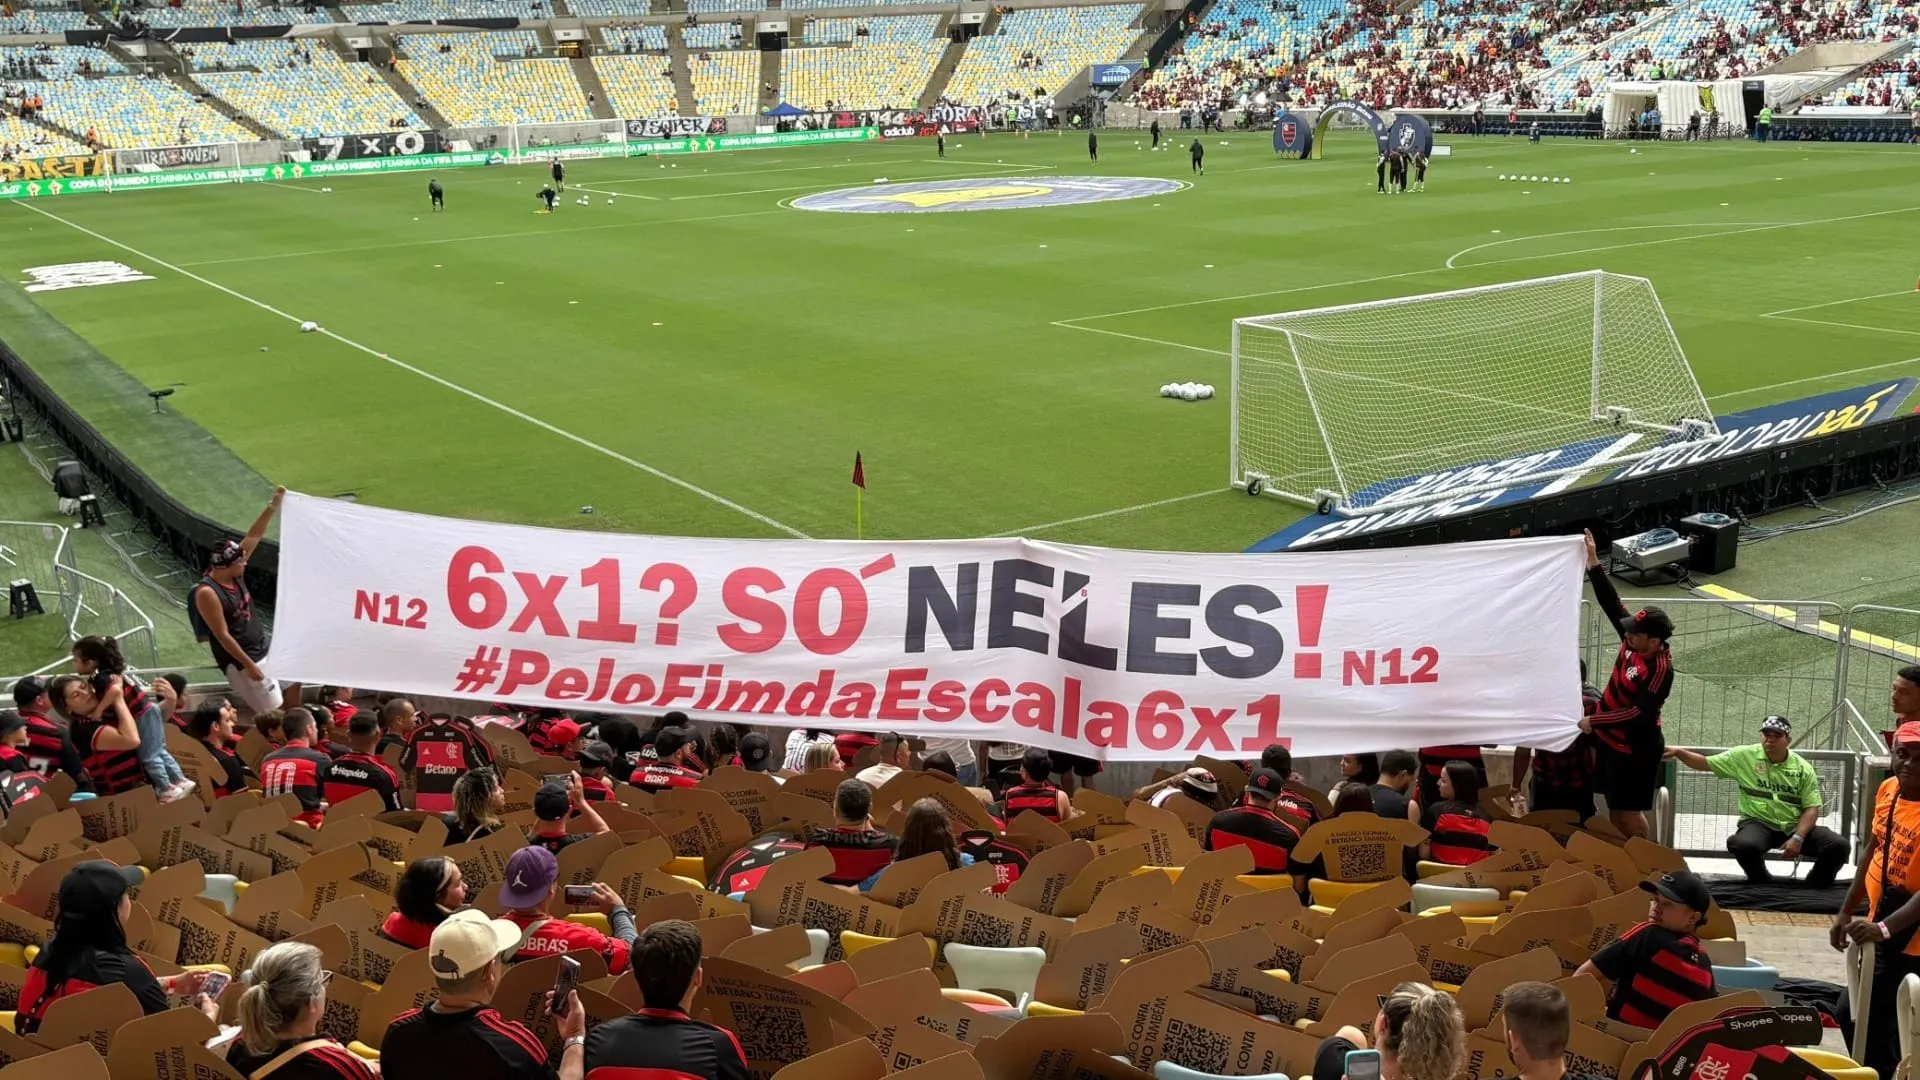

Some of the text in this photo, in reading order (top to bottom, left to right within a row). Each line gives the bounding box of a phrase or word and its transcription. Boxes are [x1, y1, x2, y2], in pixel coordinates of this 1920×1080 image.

[355, 590, 428, 630] N12
[448, 546, 1328, 680] 6x1? SÓ NELES!
[1343, 646, 1439, 685] N12
[455, 645, 1291, 752] #PeloFimdaEscala6x1
[264, 761, 297, 797] 10
[1730, 1016, 1774, 1031] Shopee
[1236, 1030, 1257, 1070] CONTA
